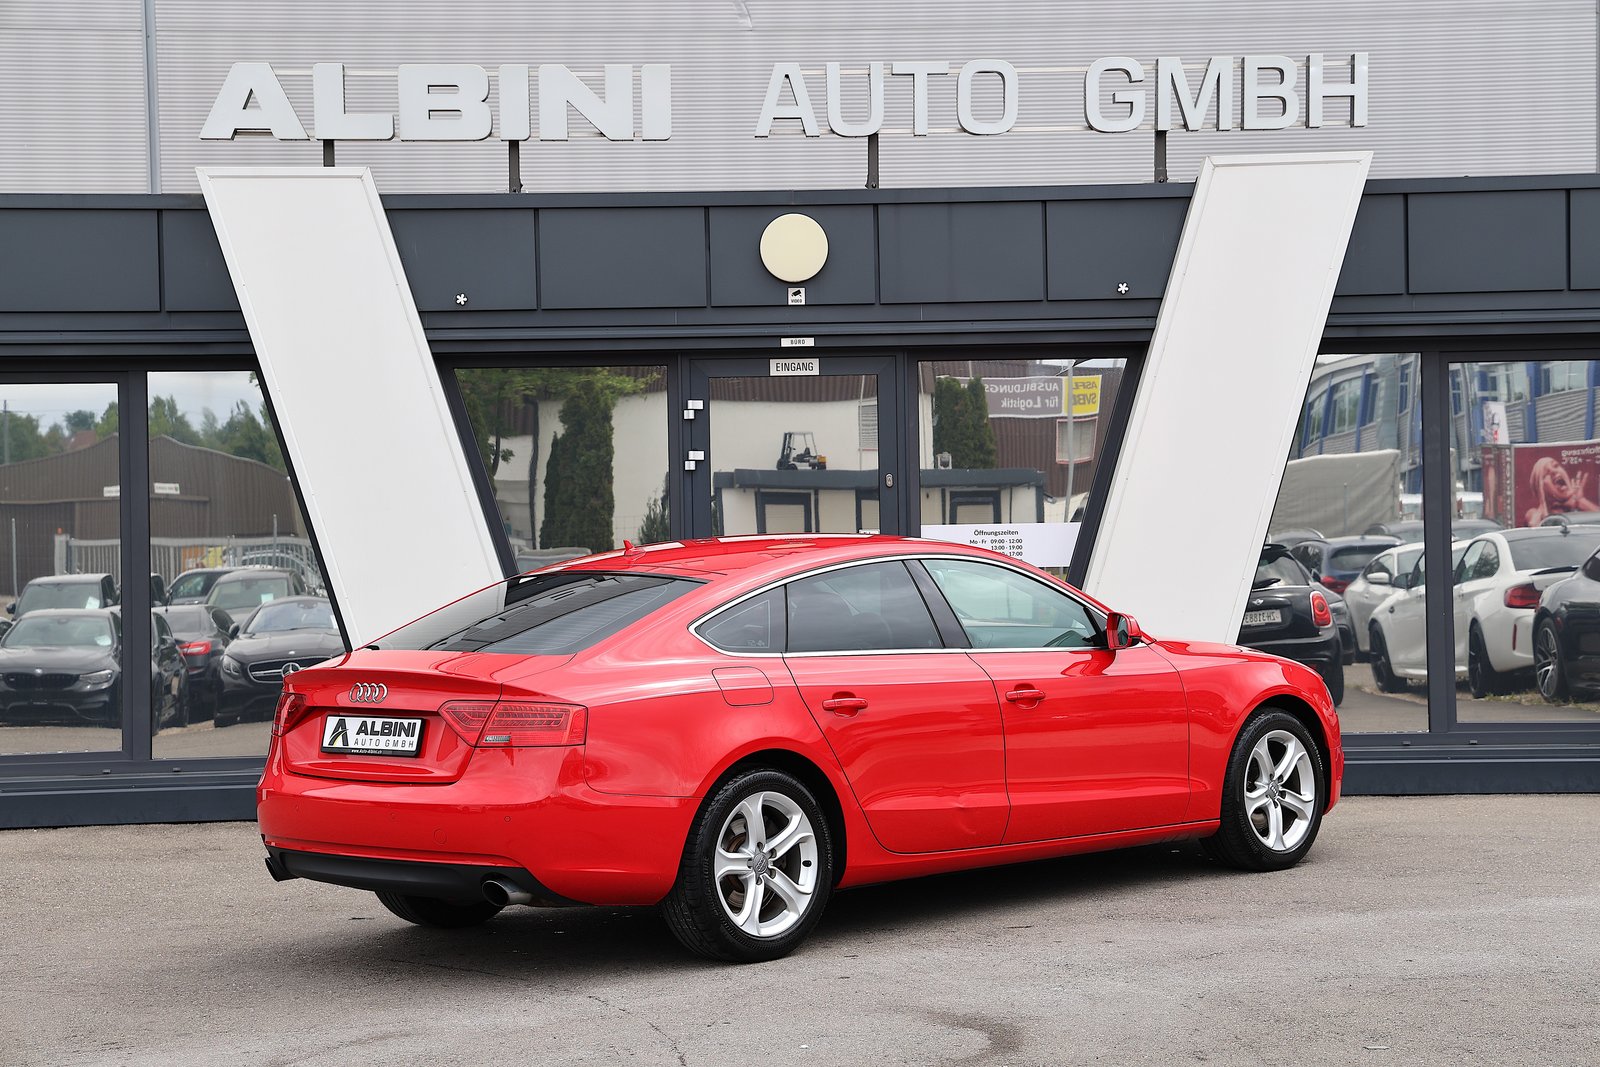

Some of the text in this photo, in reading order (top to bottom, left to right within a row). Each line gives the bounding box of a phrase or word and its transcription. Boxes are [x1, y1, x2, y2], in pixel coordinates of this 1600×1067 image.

[199, 52, 1369, 141] ALBINI AUTO GMBH
[775, 361, 814, 372] EINGANG
[973, 529, 1019, 537] Öffnungszeiten
[356, 720, 417, 737] ALBINI
[353, 738, 414, 748] AUTO GMBH
